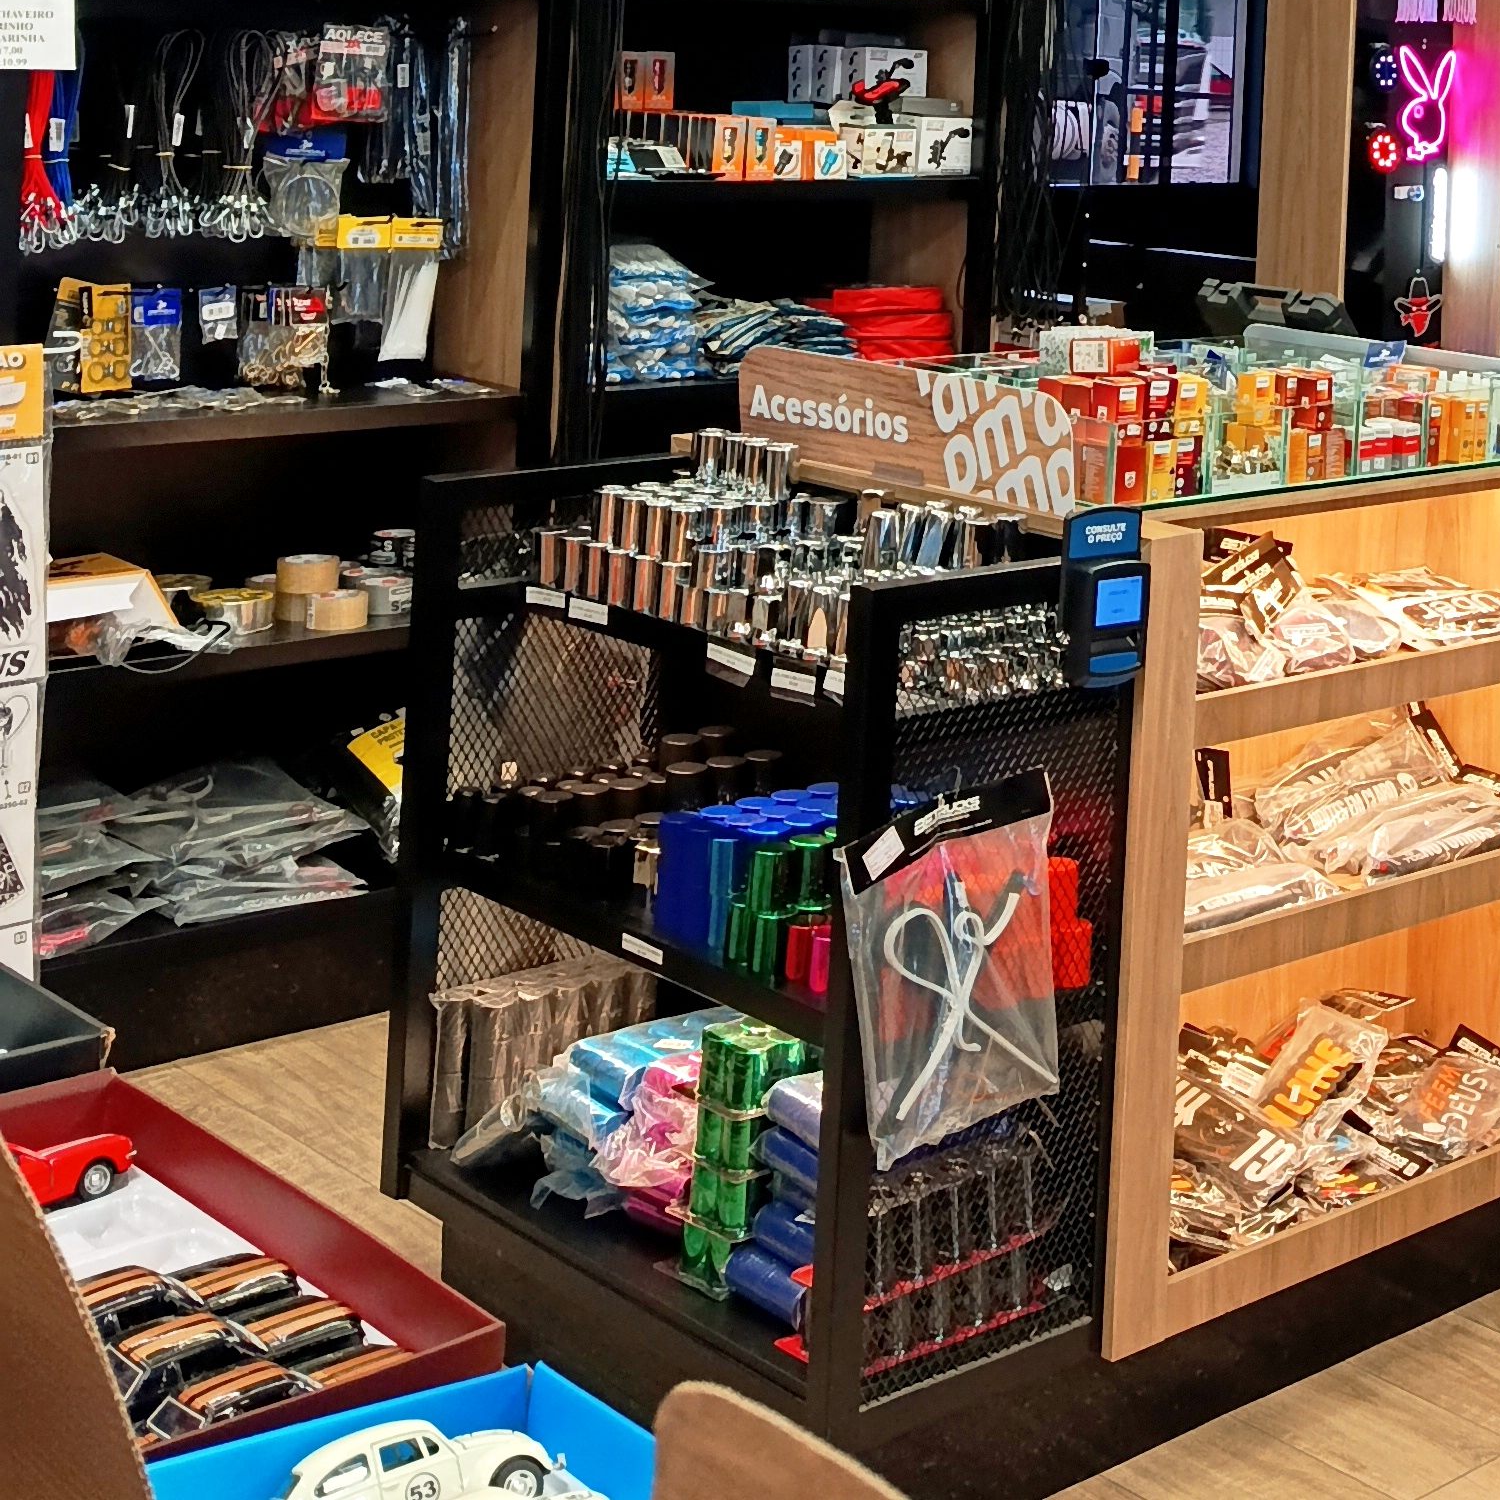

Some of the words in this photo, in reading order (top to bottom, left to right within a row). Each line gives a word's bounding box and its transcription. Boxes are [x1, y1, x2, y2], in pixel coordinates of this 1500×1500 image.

[749, 384, 909, 443] Acessórios
[1085, 522, 1127, 534] CONSULTE
[1096, 532, 1123, 543] PREÇO
[410, 1480, 437, 1500] 53
